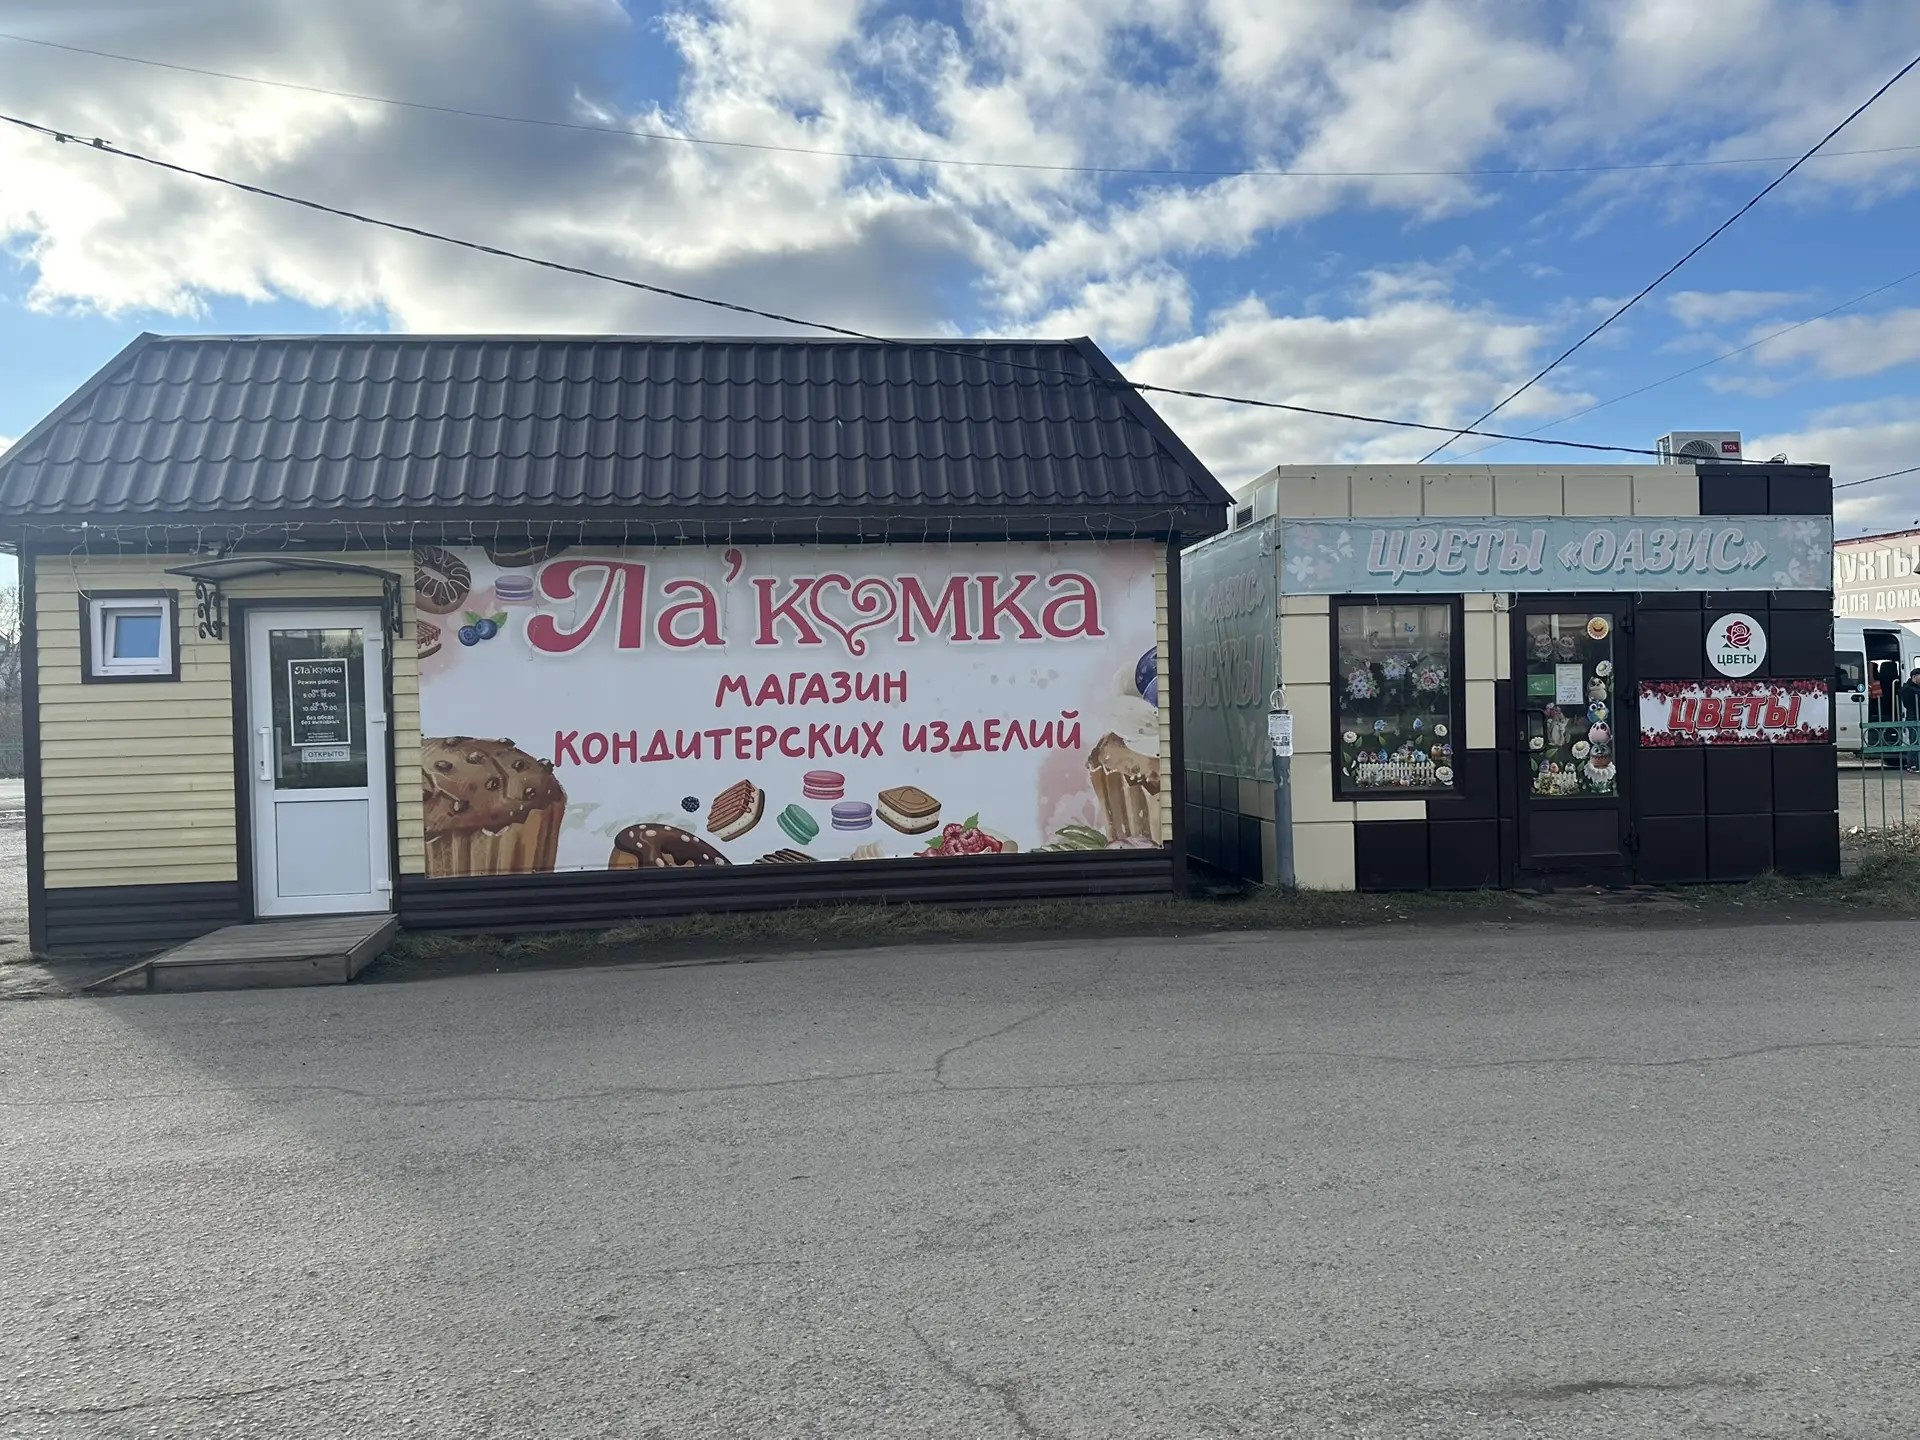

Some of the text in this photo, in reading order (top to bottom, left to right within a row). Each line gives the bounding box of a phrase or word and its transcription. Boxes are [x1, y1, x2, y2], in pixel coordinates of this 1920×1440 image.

[1366, 526, 1769, 586] ЦВЕТЫ «ОАЗИС»
[1838, 593, 1869, 616] ДЛЯ
[1717, 654, 1757, 666] ЦВЕТЫ
[715, 670, 908, 708] МАГАЗИН
[1667, 695, 1802, 733] ЦВЕТЫ
[308, 750, 345, 758] ОТКРЫТО
[554, 710, 1082, 768] КОНДИТЕРСКИХ ИЗДЕЛИЙ
